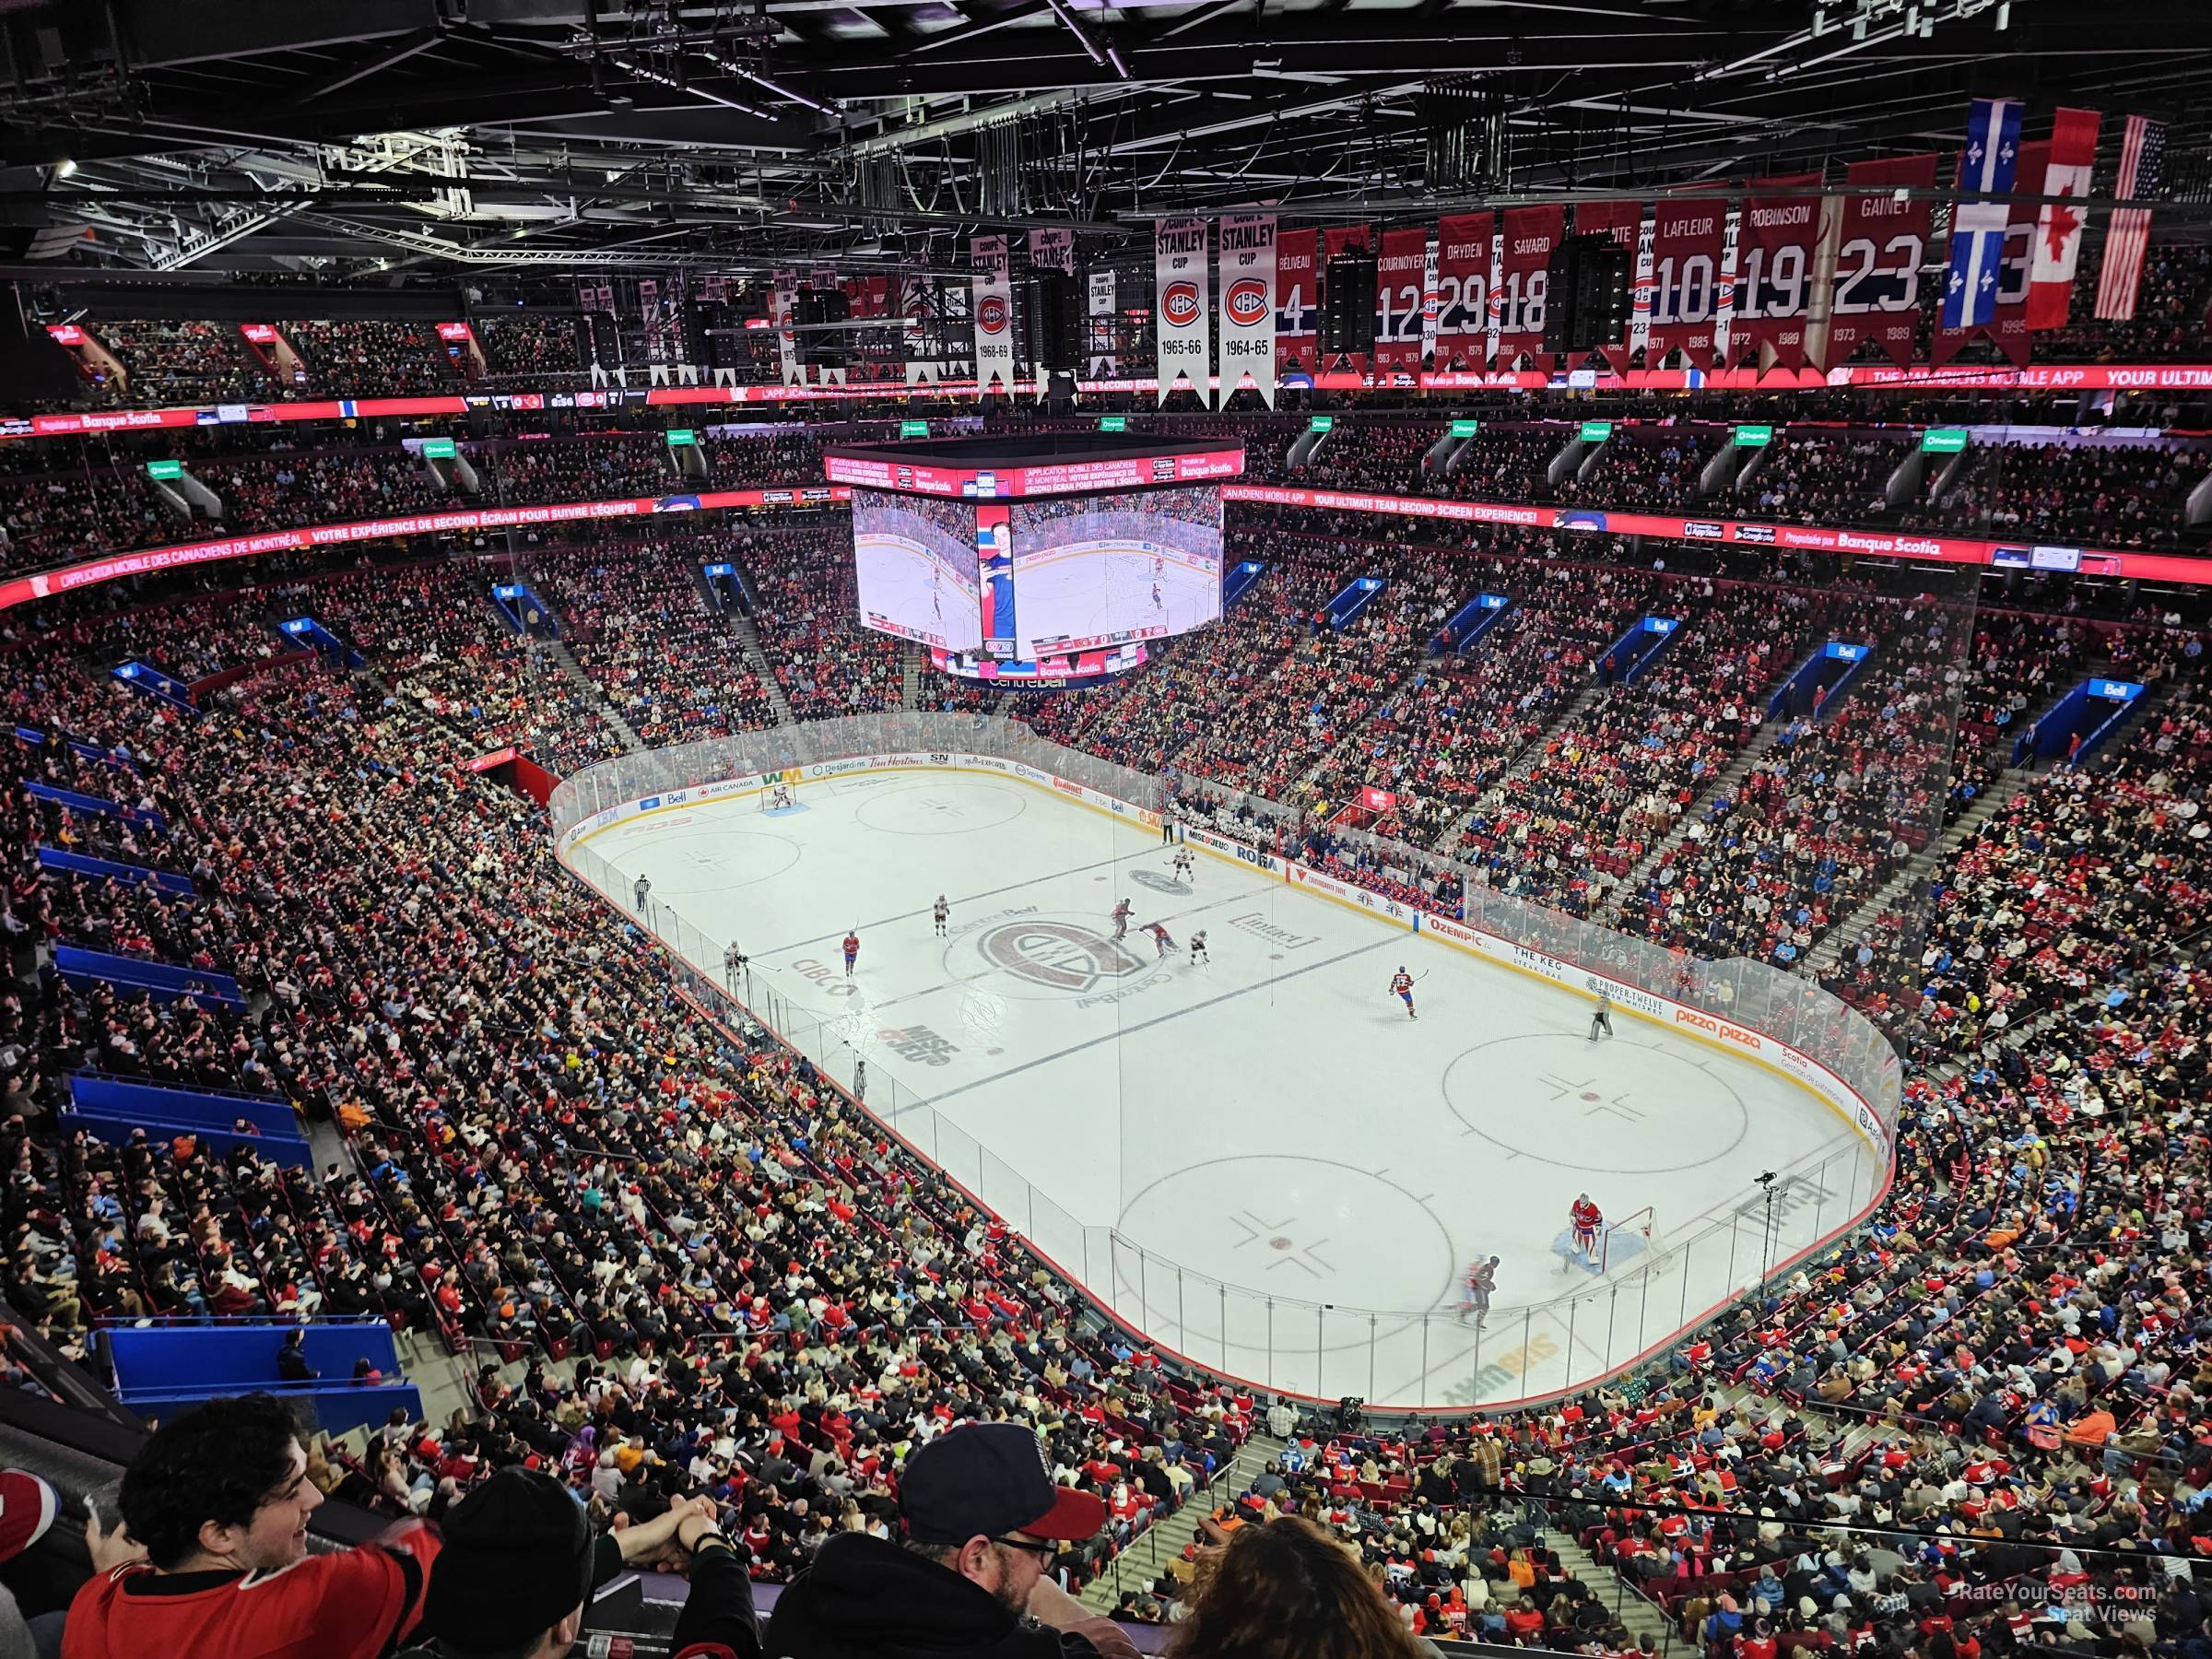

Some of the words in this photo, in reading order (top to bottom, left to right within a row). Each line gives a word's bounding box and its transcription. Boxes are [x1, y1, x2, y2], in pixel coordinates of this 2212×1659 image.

[1861, 198, 1912, 218] GAINEY
[1749, 206, 1810, 227] ROBINSON
[1664, 218, 1713, 238] LAFLEUR
[1159, 229, 1206, 255] STANLEY
[1223, 223, 1275, 251] STANLEY
[980, 241, 998, 252] COUPE
[1448, 242, 1482, 260] DRYDEN
[1514, 237, 1549, 254] SAVARD
[1033, 244, 1071, 268] STANLEY
[1172, 257, 1188, 269] CUP
[1239, 253, 1256, 265] CUP
[1279, 253, 1311, 270] BÉLIVEAU
[1378, 255, 1424, 272] COURNOYER
[985, 276, 996, 286] CUP
[1834, 235, 1923, 314] 23
[1652, 254, 1713, 324] 10
[1737, 245, 1806, 319] 19
[1091, 285, 1115, 297] STANLEY
[1438, 275, 1486, 335] 29
[1503, 271, 1548, 334] 18
[1284, 284, 1303, 336] 4
[1378, 286, 1420, 343] 12
[1887, 327, 1910, 340] 1989
[2002, 320, 2026, 334] 1995
[1688, 336, 1709, 347] 1985
[1732, 333, 1751, 345] 1972
[1779, 333, 1799, 345] 1989
[1834, 328, 1855, 341] 1973
[1162, 340, 1201, 354] 1965-66
[1226, 340, 1268, 355] 1964-65
[1649, 337, 1665, 348] 1971
[980, 345, 1008, 358] 1968-69
[1301, 347, 1312, 356] 1971
[1436, 346, 1449, 356] 1970
[1468, 346, 1482, 355] 1979
[1500, 345, 1514, 355] 1966
[1378, 354, 1390, 363] 1963
[1406, 353, 1418, 362] 1979
[2052, 371, 2084, 384] APP
[2108, 371, 2155, 385] YOUR
[1099, 381, 1133, 390] SECOND
[82, 415, 126, 429] Banque
[127, 414, 161, 426] Scotia
[1105, 461, 1136, 470] CANADIENS
[1182, 467, 1209, 478] Banque
[1210, 464, 1232, 474] Scotia
[1025, 485, 1051, 493] SECOND
[1265, 491, 1289, 501] MOBILE
[1291, 492, 1305, 503] APP
[1314, 495, 1335, 506] YOUR
[1336, 497, 1374, 512] ULTIMATE
[1376, 500, 1397, 513] TEAM
[1399, 502, 1473, 519] SECOND-SCREEN
[1475, 508, 1536, 523] EXPERIENCE!
[115, 558, 150, 578] MOBILE
[151, 554, 171, 571] DES
[172, 544, 231, 564] CANADIENS
[232, 542, 248, 555] DE
[250, 533, 304, 551] MONTRÉAL
[312, 528, 348, 542] VOTRE
[351, 521, 417, 540] EXPÉRIENCE
[418, 519, 431, 530] DE
[434, 514, 478, 529] SECOND
[480, 510, 517, 525] ÉCRAN
[520, 509, 548, 522] POUR
[550, 506, 588, 520] SUIVRE
[590, 502, 637, 516] L'ÉQUIPE!
[1838, 533, 1893, 551] Banque
[1895, 537, 1941, 555] Scotia
[1654, 621, 1668, 630] Bell
[1839, 647, 1855, 657] Bell
[1041, 666, 1070, 677] Banque
[2104, 683, 2126, 696] Bell
[825, 760, 865, 773] Desjardins
[869, 757, 885, 768] Tim
[888, 756, 924, 767] Hortons
[762, 768, 803, 785] WM
[724, 781, 754, 792] CANADA
[1053, 776, 1083, 795] Qualinet
[668, 791, 687, 805] Bell
[1112, 799, 1124, 813] Bell
[597, 807, 619, 828] IBM
[1237, 845, 1277, 873] ROA
[1513, 947, 1536, 961] THE
[1540, 955, 1562, 971] KEG
[792, 959, 833, 987] CIBC
[1676, 1008, 1715, 1034] pizza
[1719, 1025, 1761, 1051] pizza
[1782, 1047, 1807, 1068] Scotia
[1781, 1059, 1806, 1078] Gestion
[1805, 1075, 1816, 1086] de
